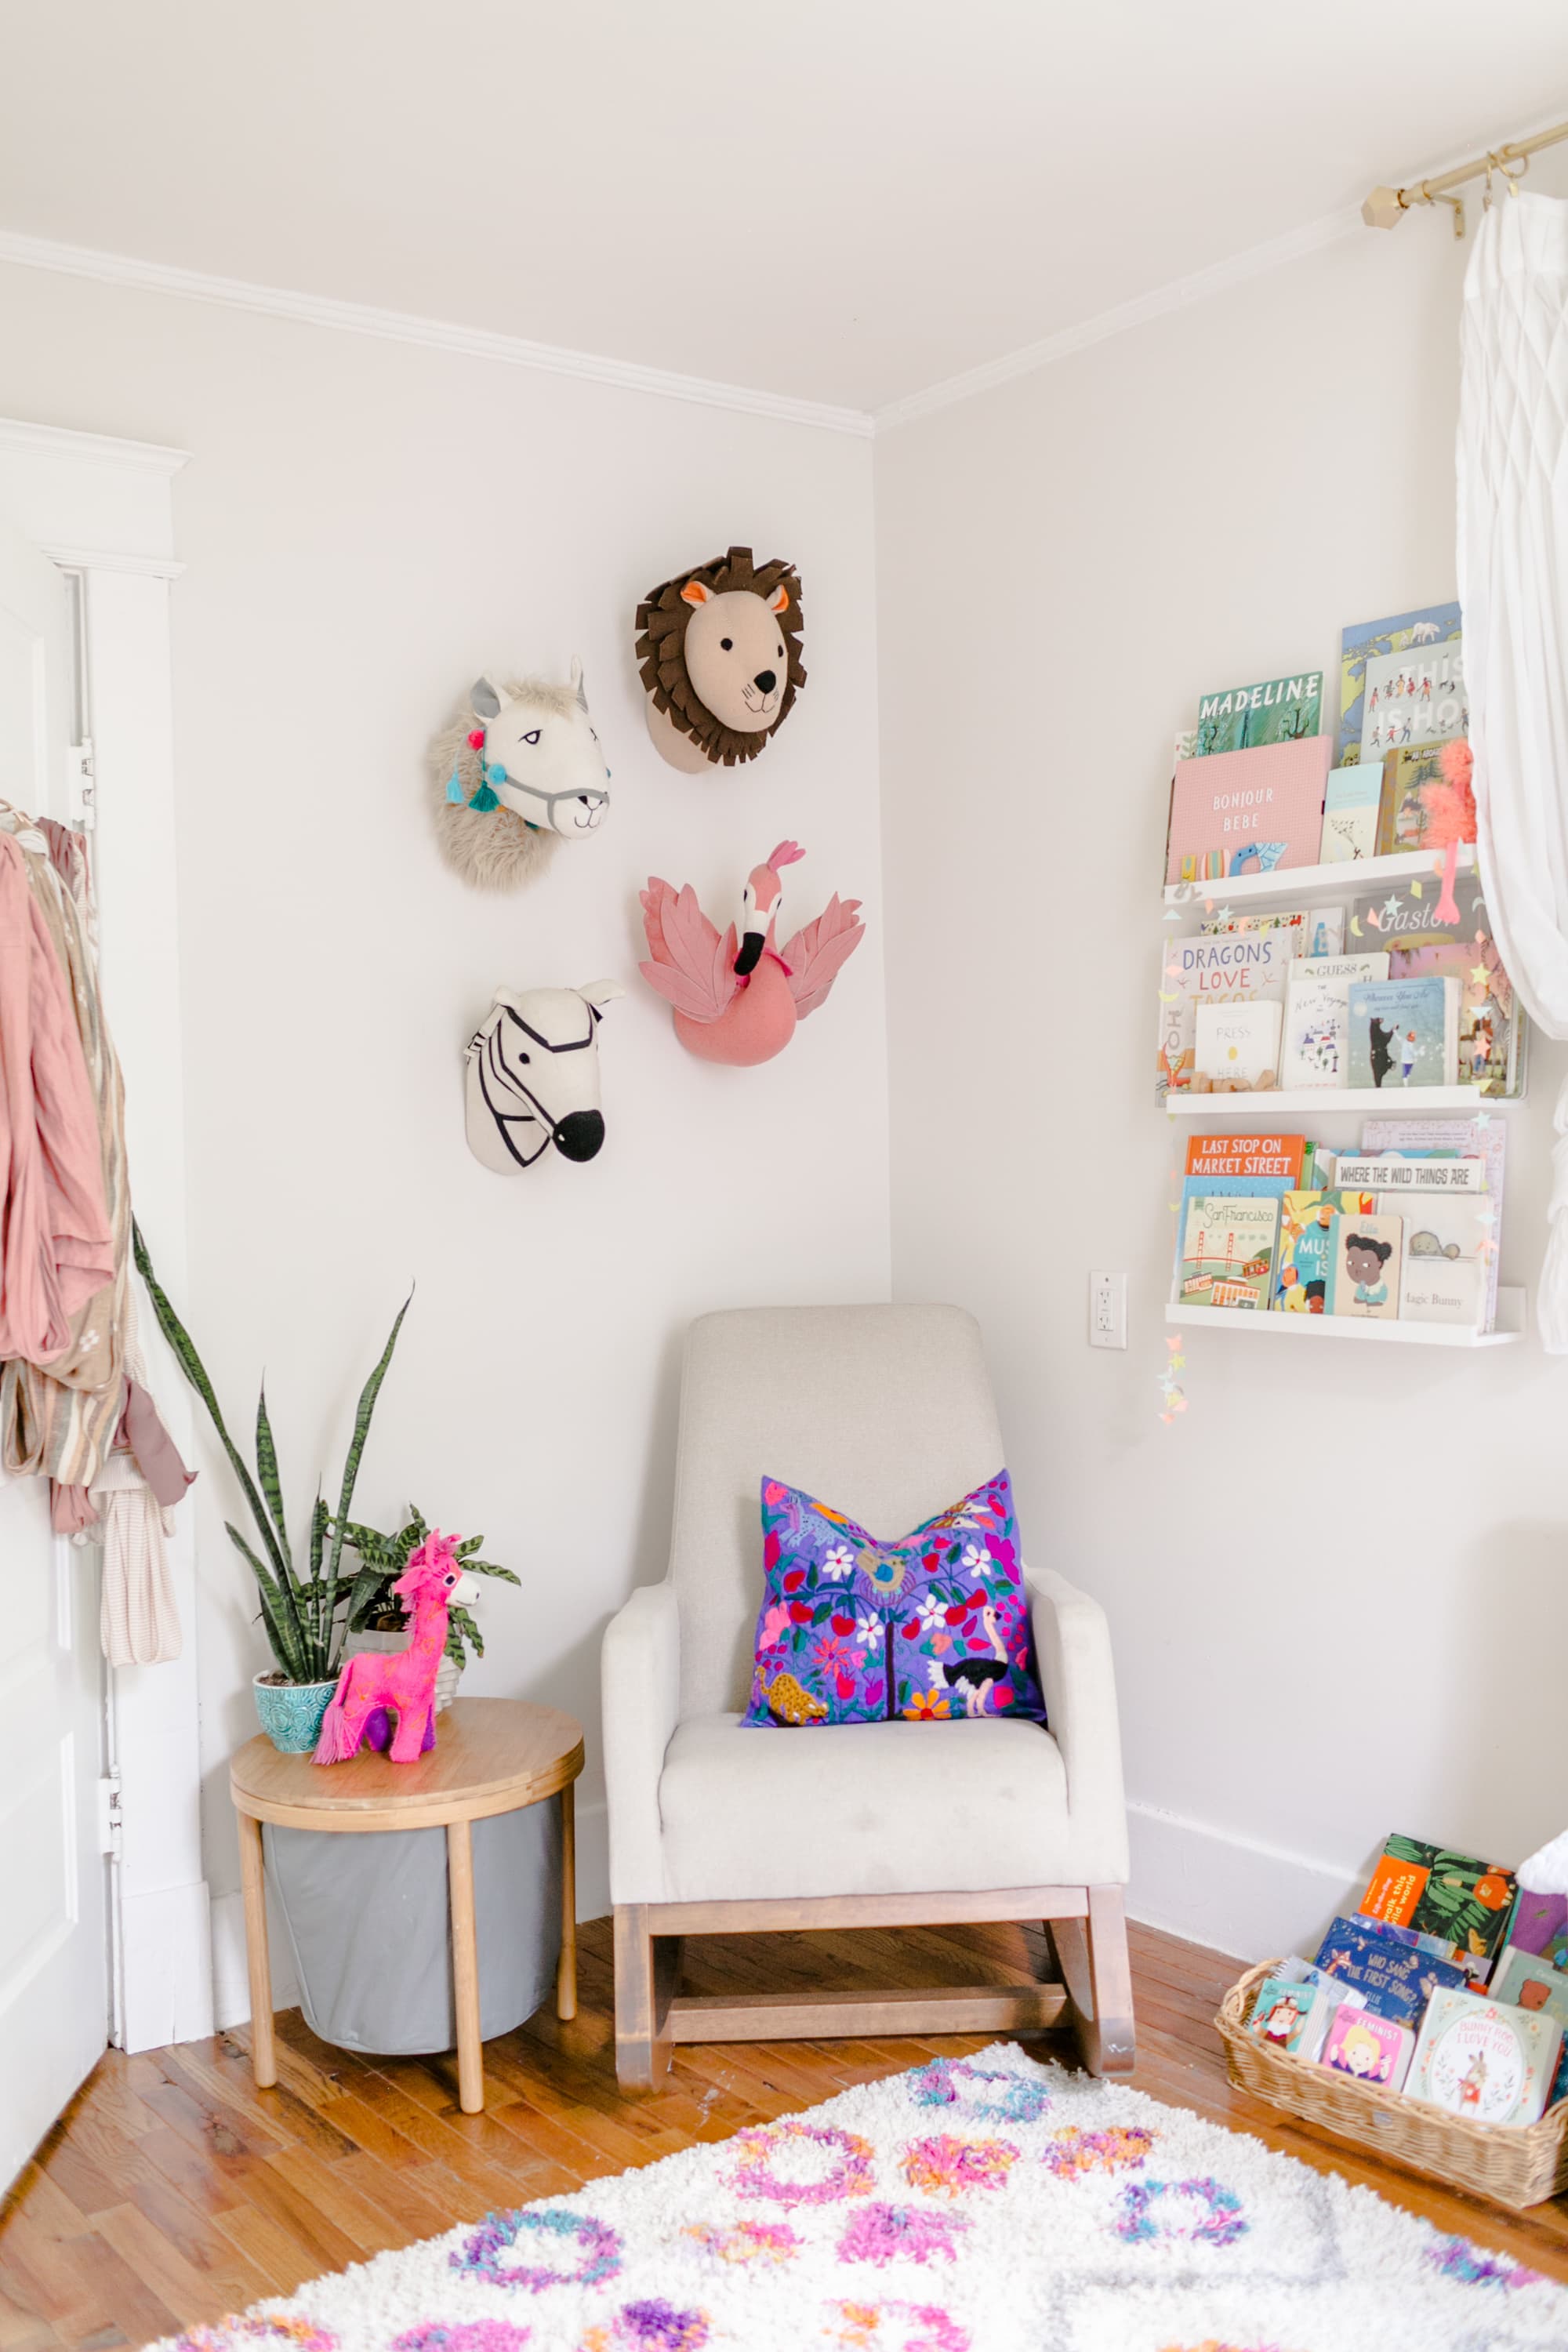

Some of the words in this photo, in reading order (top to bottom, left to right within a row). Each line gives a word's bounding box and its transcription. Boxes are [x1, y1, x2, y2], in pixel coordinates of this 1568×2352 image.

[1200, 674, 1319, 720] MADELINE
[1412, 696, 1468, 731] HO
[1213, 788, 1273, 810] BONJOUR
[1223, 813, 1258, 832] BEBE
[1377, 902, 1450, 932] Gasto
[1183, 941, 1272, 971] DRAGONS
[1200, 967, 1250, 990] LOVE
[1316, 964, 1357, 977] GUESS
[1216, 1026, 1253, 1040] PRESS
[1202, 1140, 1229, 1154] LAST
[1232, 1139, 1259, 1153] STOP
[1261, 1138, 1282, 1153] ON
[1192, 1158, 1241, 1174] MARKET
[1244, 1156, 1292, 1174] STREET
[1341, 1167, 1370, 1182] WHERE
[1373, 1167, 1388, 1183] THE
[1391, 1168, 1412, 1184] WILD
[1415, 1168, 1448, 1185] THINGS
[1450, 1168, 1470, 1185] ARE
[1432, 1293, 1463, 1309] Bunny
[1393, 1875, 1406, 1896] this
[1399, 1874, 1416, 1904] world
[1367, 1953, 1387, 1970] WHO
[1386, 1960, 1411, 1980] SANG
[1363, 1969, 1390, 1988] FIRST
[1388, 1980, 1417, 2002] SONG?
[1356, 2016, 1398, 2041] FEMINIST
[1460, 2021, 1493, 2032] BUNNY
[1465, 2032, 1489, 2047] LOVE
[1492, 2041, 1512, 2057] YOU
